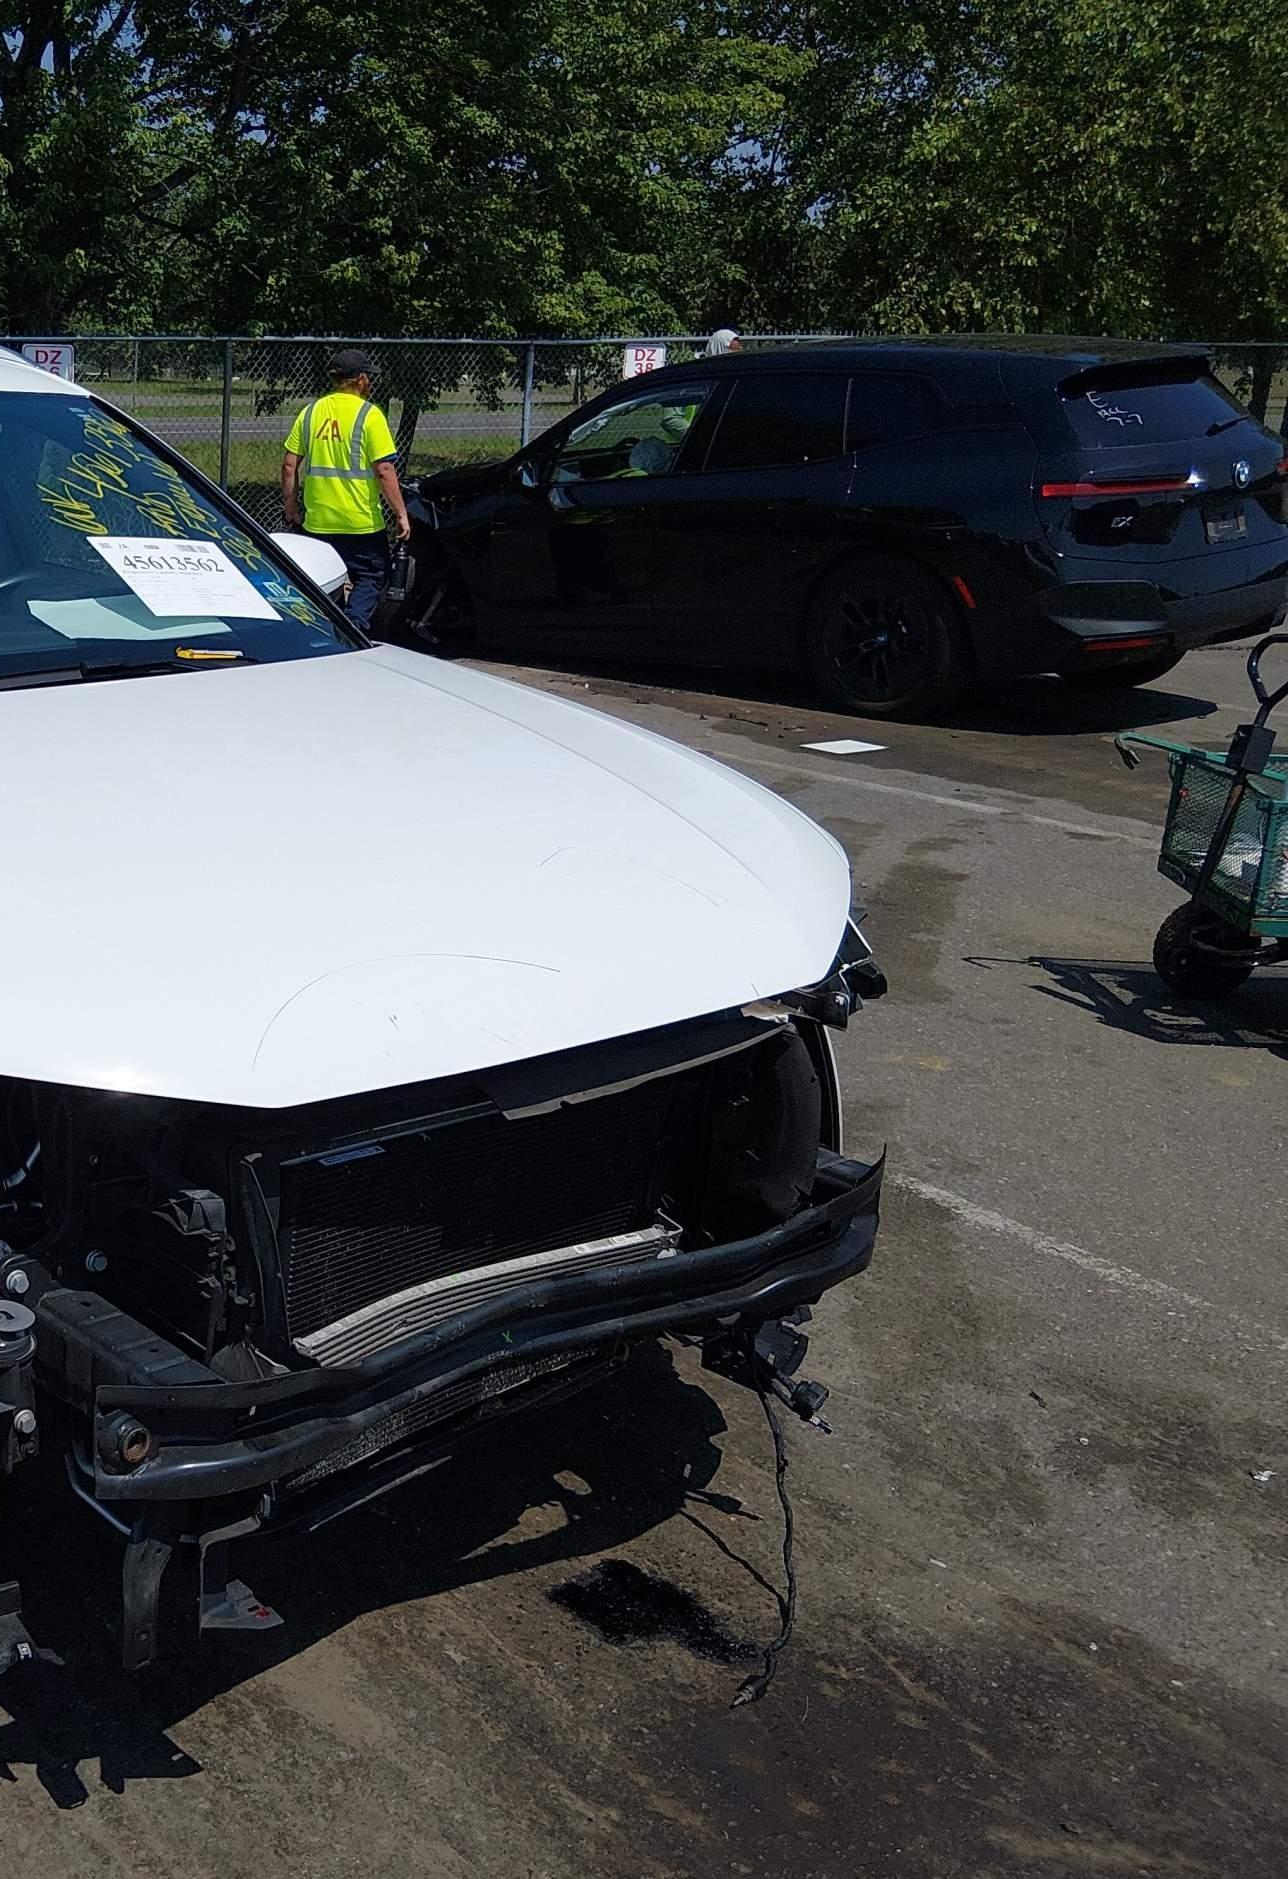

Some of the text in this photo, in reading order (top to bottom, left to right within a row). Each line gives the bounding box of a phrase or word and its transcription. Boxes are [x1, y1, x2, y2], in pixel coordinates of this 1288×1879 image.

[35, 350, 62, 365] DZ
[635, 349, 657, 362] DZ
[123, 555, 225, 573] 45613562
